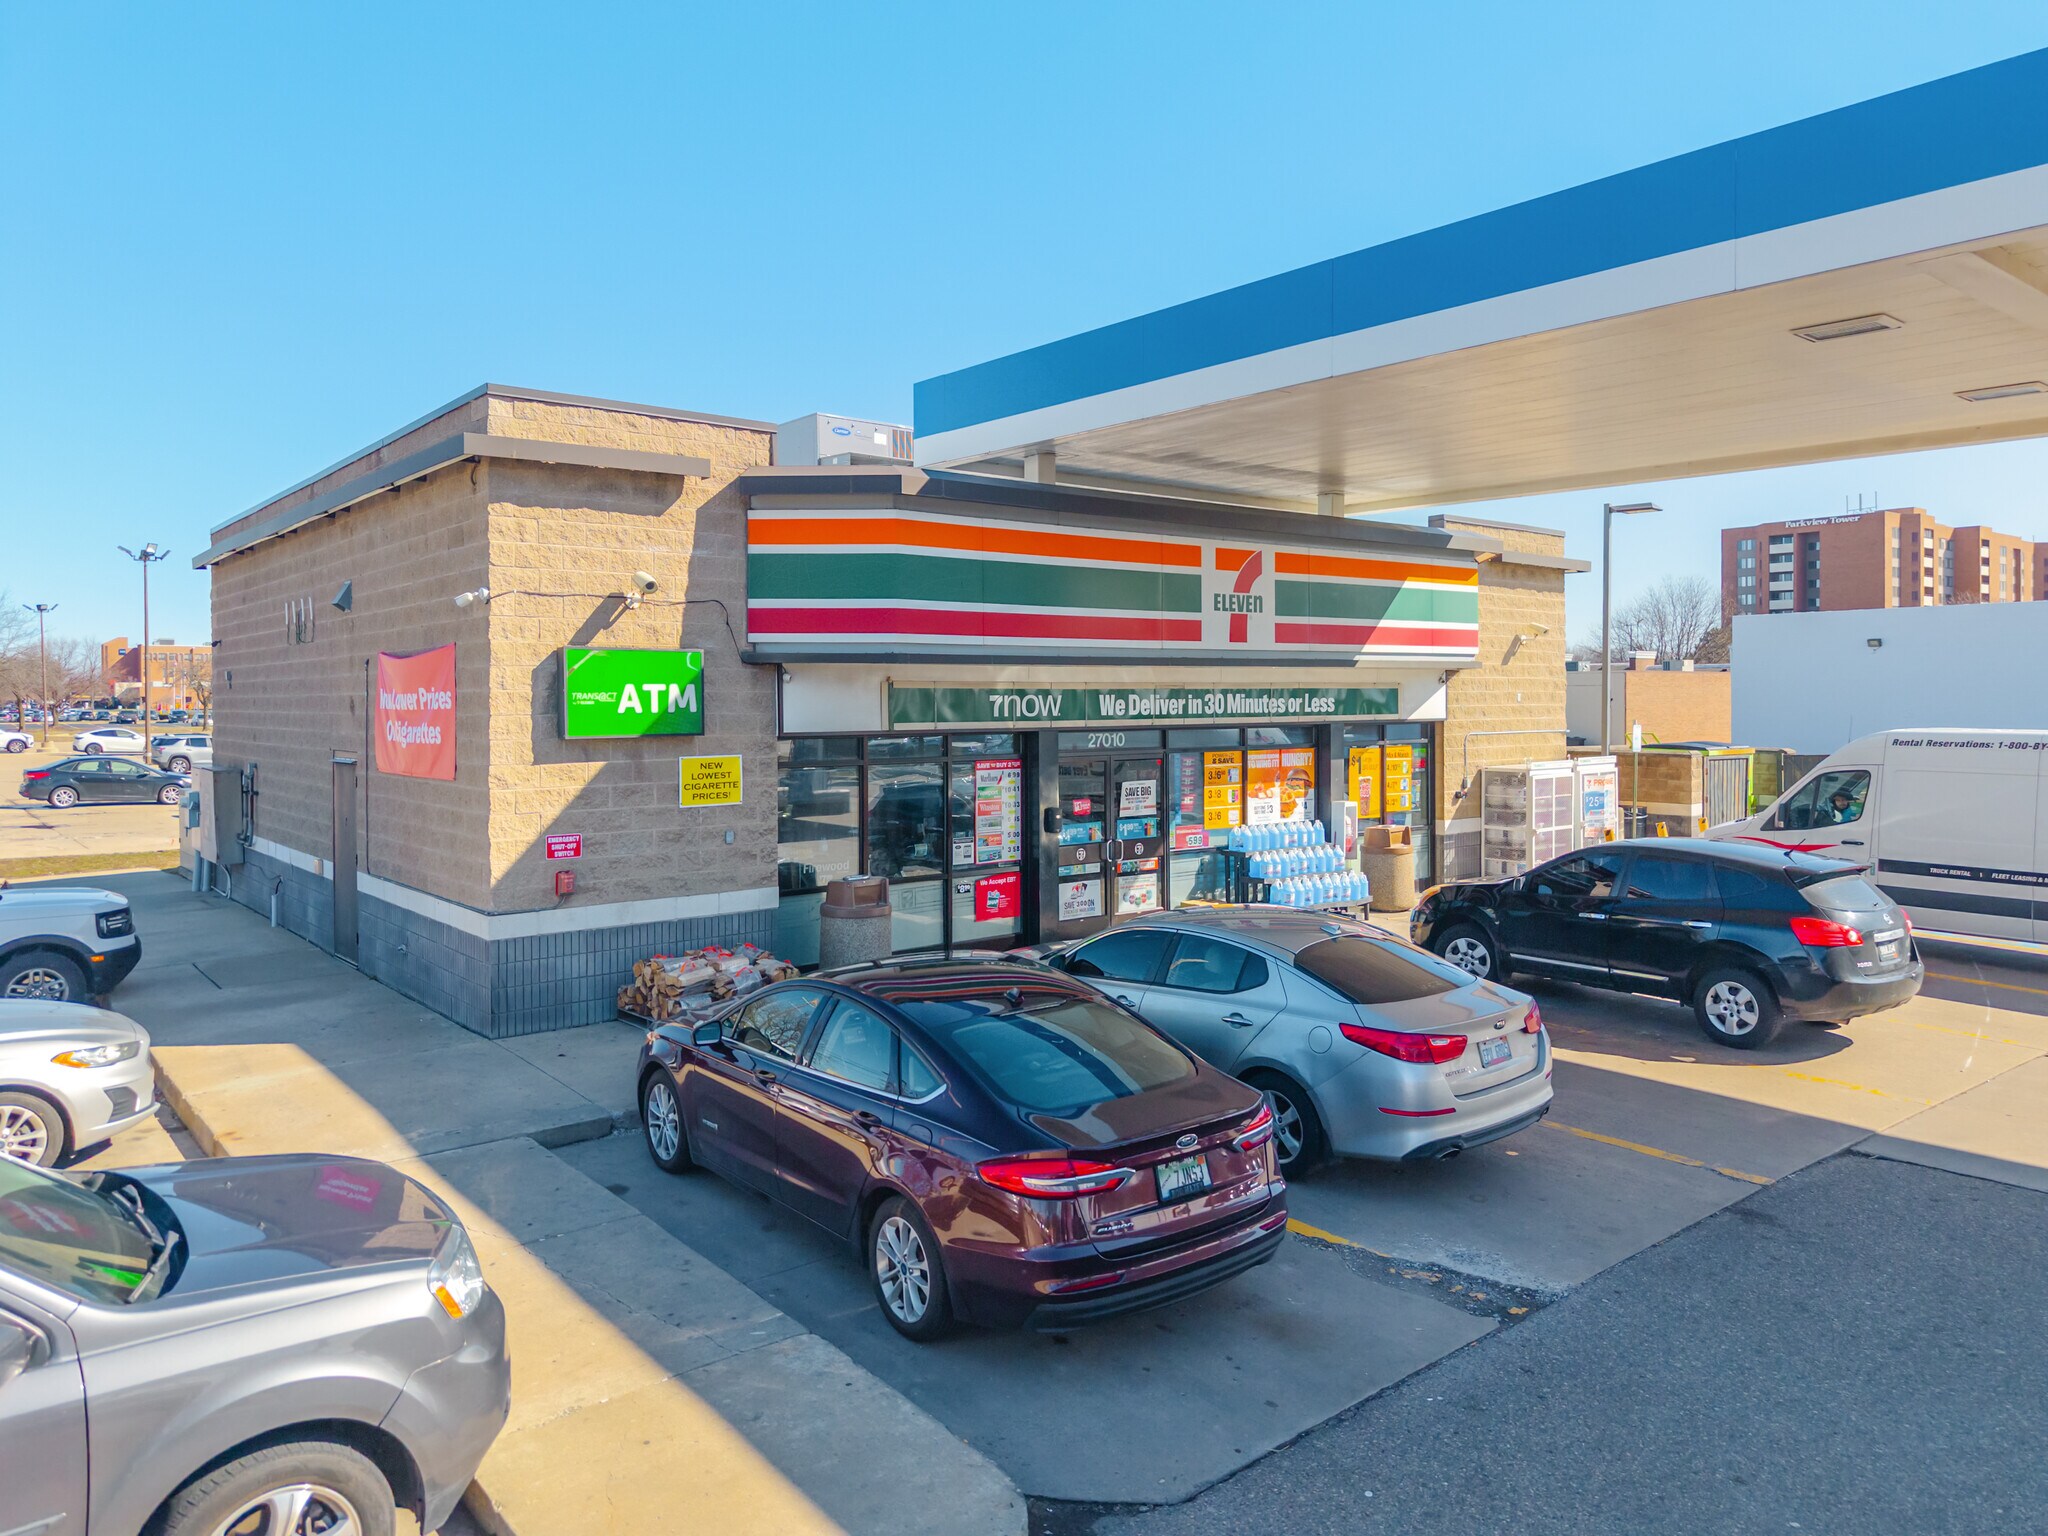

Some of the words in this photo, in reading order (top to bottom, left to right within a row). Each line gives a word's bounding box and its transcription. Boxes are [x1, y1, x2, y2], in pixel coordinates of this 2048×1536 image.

[1785, 517, 1828, 528] Parkview
[1829, 515, 1860, 524] Tower
[418, 687, 452, 710] Prices
[617, 683, 697, 714] ATM
[1099, 694, 1126, 716] We
[1128, 694, 1186, 716] Deliver
[1188, 694, 1203, 715] in
[1204, 693, 1225, 714] 30
[1226, 693, 1286, 714] Minutes
[1288, 699, 1303, 712] or
[1304, 693, 1335, 713] Less
[1088, 732, 1125, 748] 27010
[1892, 738, 1923, 747] Rental
[1925, 739, 1994, 749] Reservations:
[691, 771, 732, 780] LOWEST
[683, 781, 739, 791] CIGARETTE
[1125, 786, 1140, 797] SAVE
[1140, 786, 1152, 796] BIG
[692, 792, 731, 800] PRICES!
[1929, 867, 1949, 875] TRUCK
[1949, 869, 1972, 877] RENTAL
[1991, 872, 2011, 880] FLEET
[2010, 874, 2038, 883] LEASING
